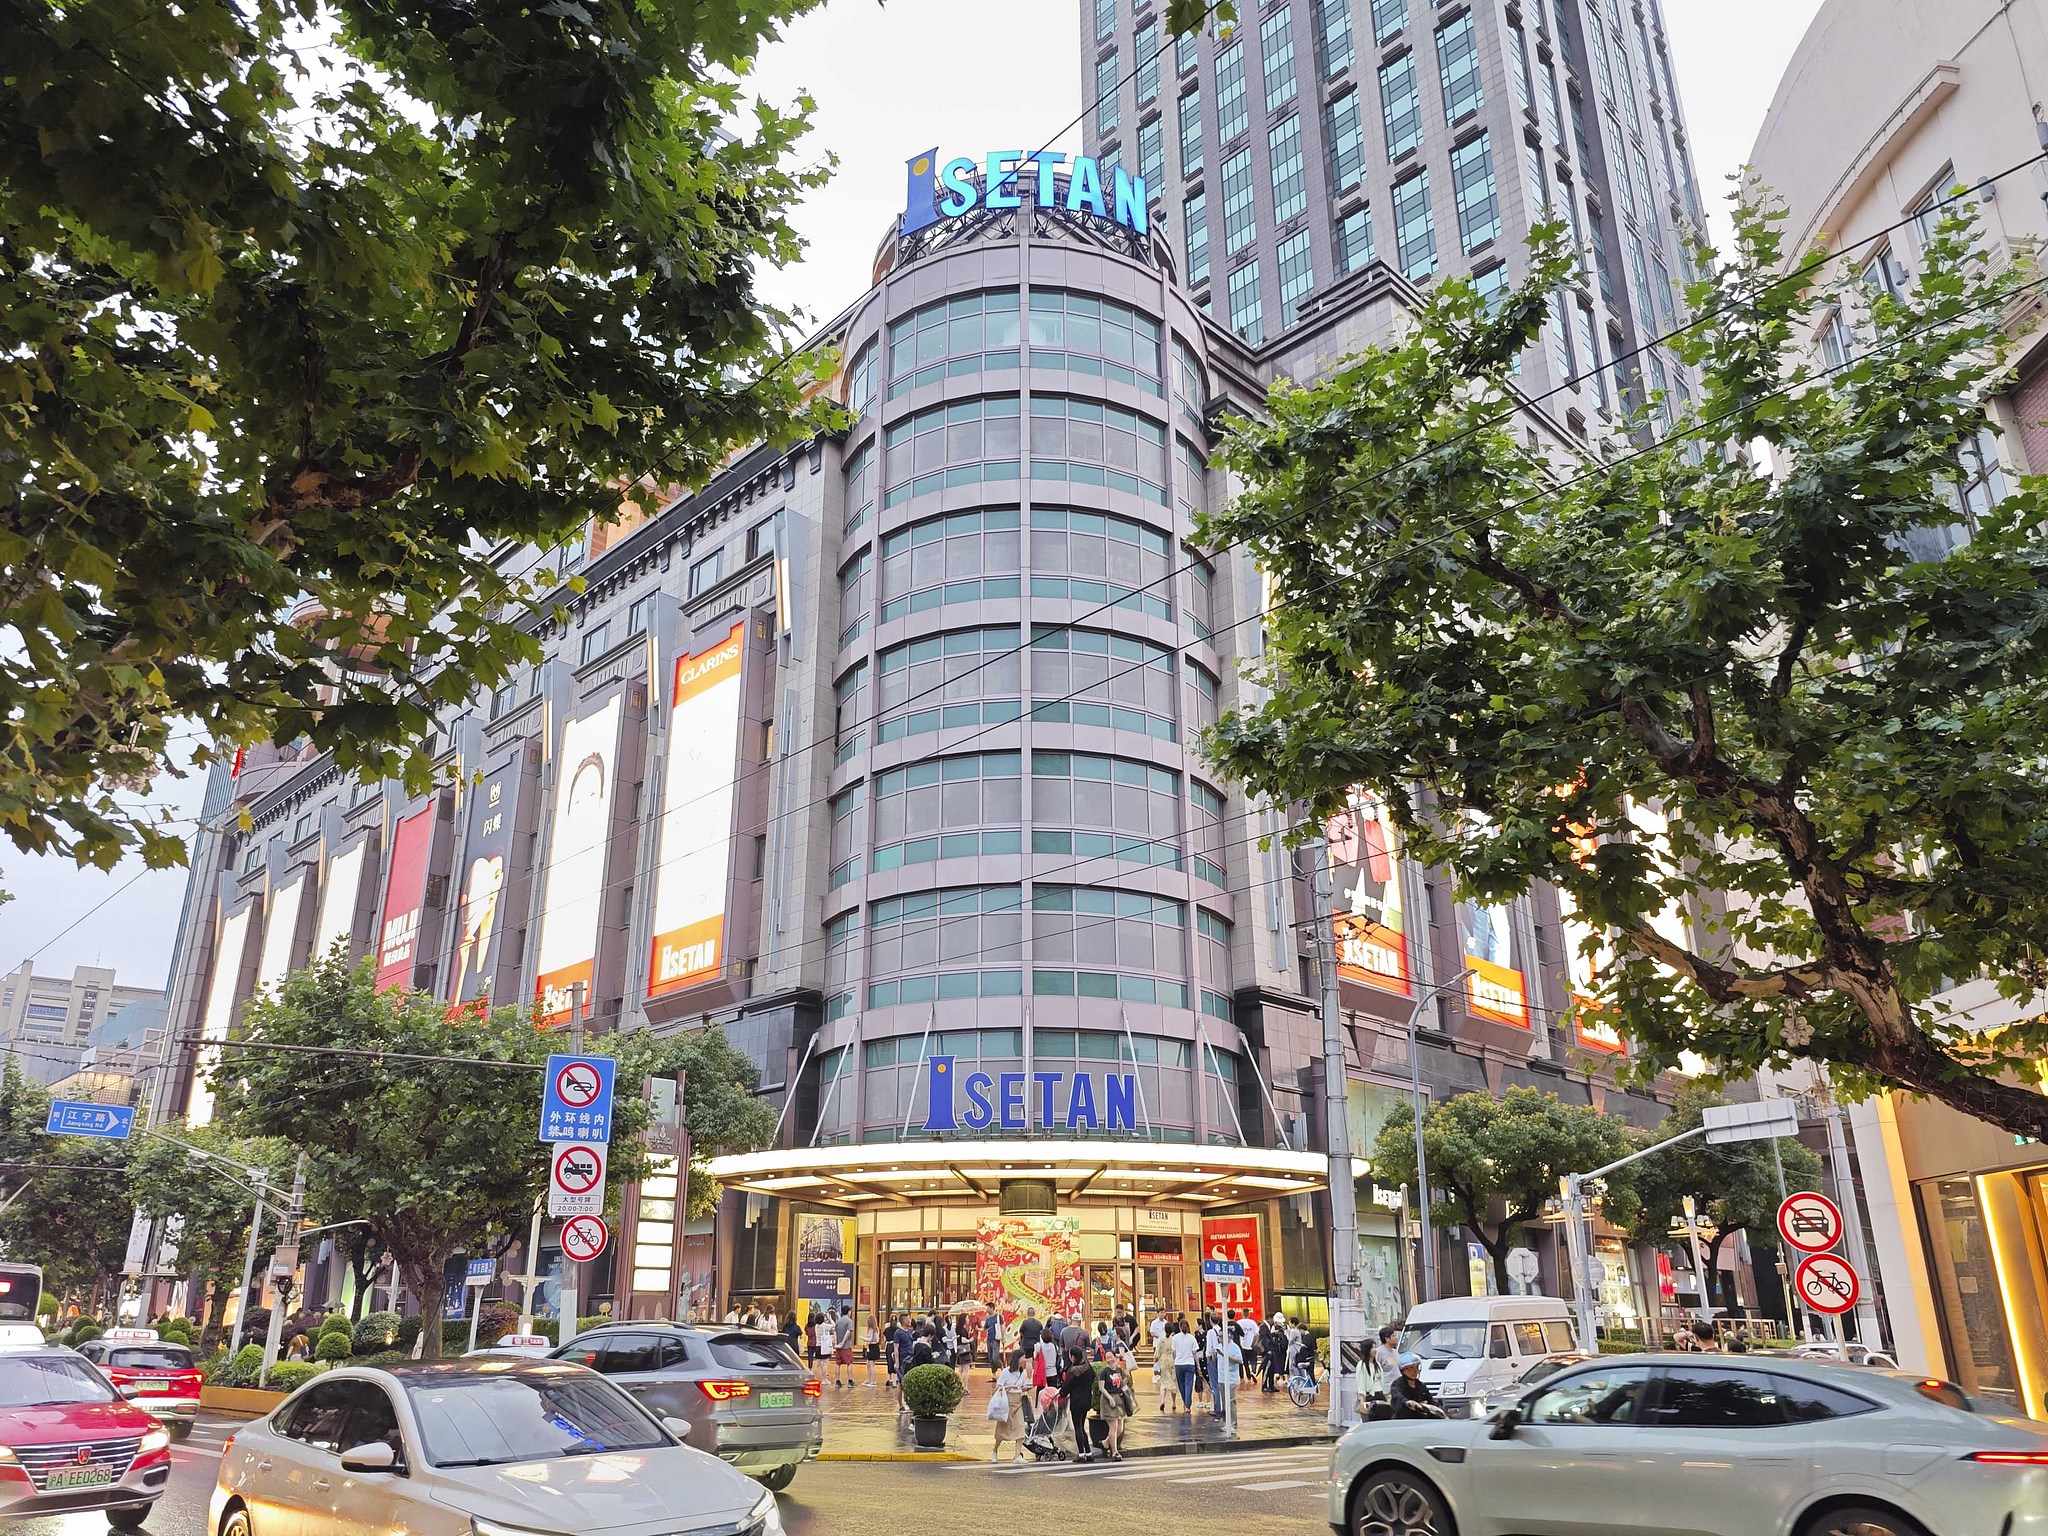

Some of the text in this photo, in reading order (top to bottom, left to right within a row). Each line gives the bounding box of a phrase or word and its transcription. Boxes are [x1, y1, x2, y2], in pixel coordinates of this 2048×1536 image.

[899, 147, 1147, 237] ISETAN
[681, 643, 739, 684] CLARINS
[383, 908, 419, 951] MUJI
[659, 939, 716, 981] ISETAN
[921, 1055, 1137, 1131] ISETAN
[66, 1120, 93, 1129] Jiangning
[67, 1110, 106, 1123] 江宁路
[550, 1110, 605, 1126] 外环线内
[548, 1124, 603, 1140] 禁鸣喇叭
[562, 1196, 592, 1204] 大型号牌
[1149, 1209, 1169, 1220] ISETAN
[1226, 1231, 1250, 1239] SHANGHAI
